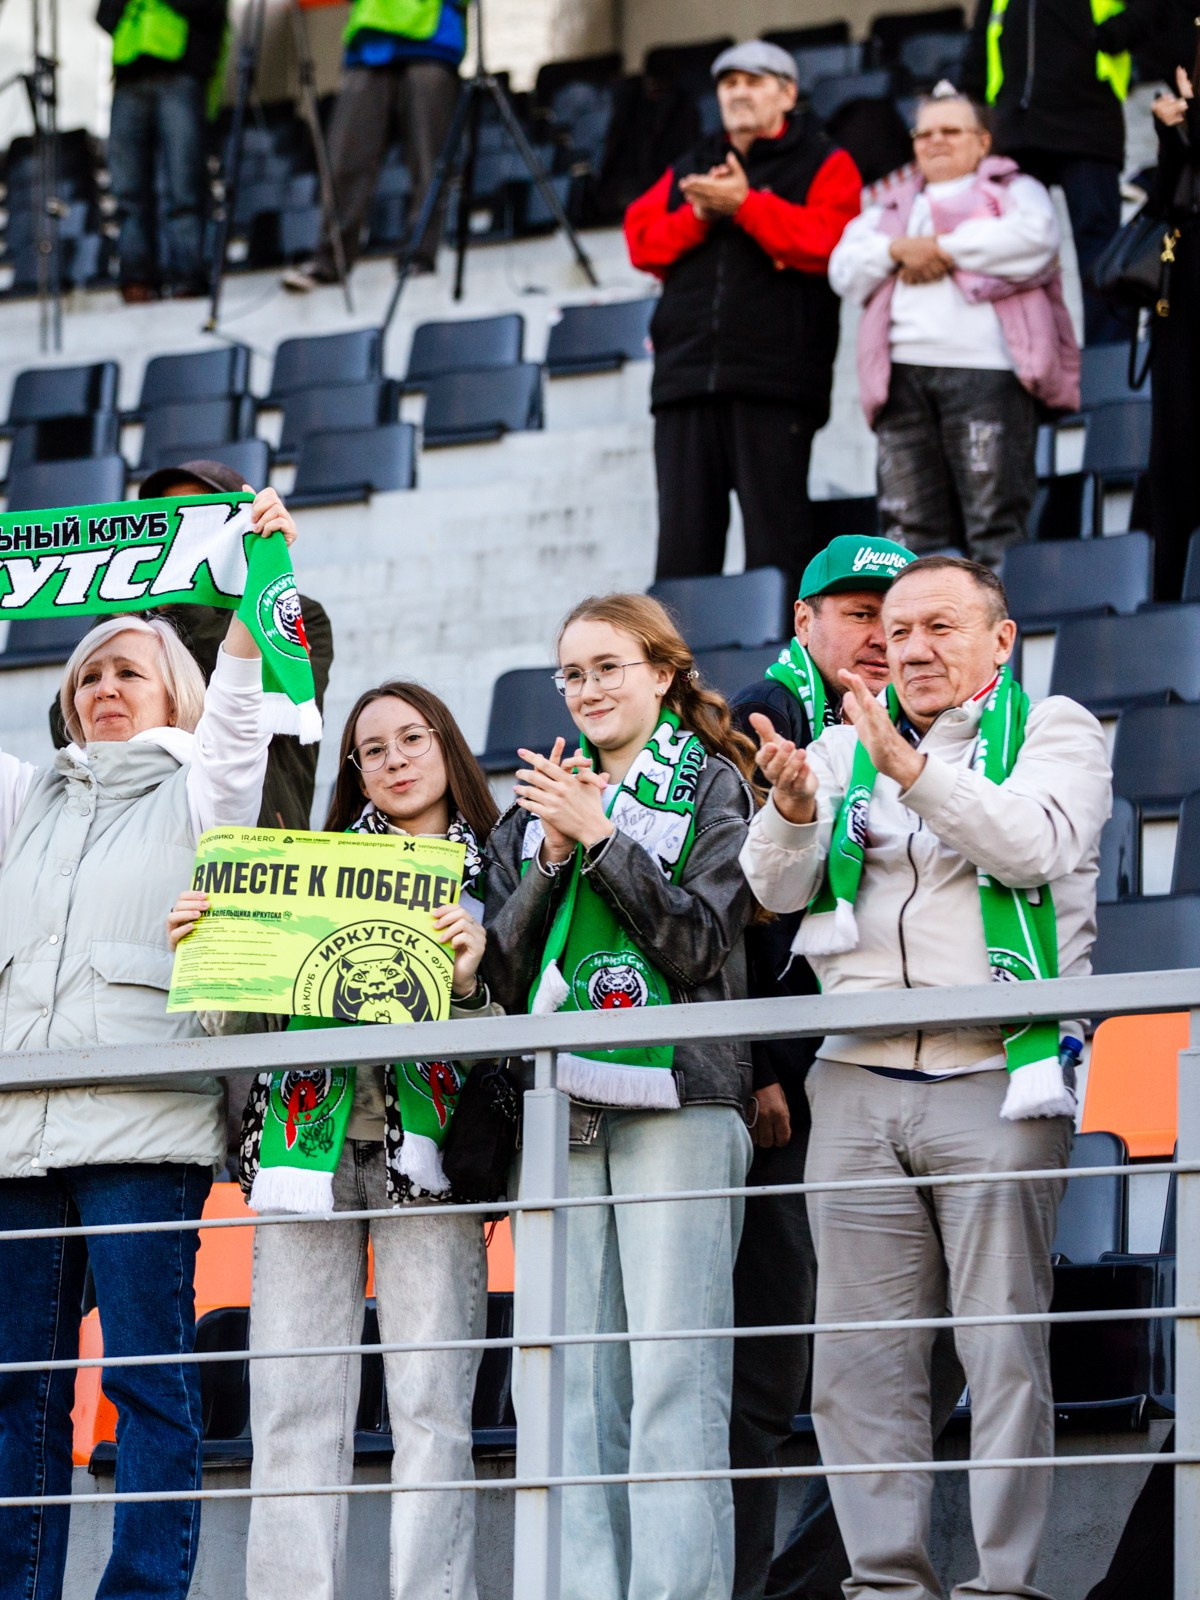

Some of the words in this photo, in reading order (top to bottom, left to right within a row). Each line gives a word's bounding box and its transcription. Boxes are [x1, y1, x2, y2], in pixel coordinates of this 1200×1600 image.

[88, 512, 169, 543] КЛУБ
[192, 861, 299, 896] ВМЕСТЕ
[308, 865, 328, 897] К
[336, 866, 459, 912] ПОБЕДЕ!
[212, 909, 251, 918] БОЛЕЛЬЩИКА
[252, 910, 282, 919] ИРКУТСКА
[319, 926, 422, 962] ИРКУТСК
[303, 973, 316, 1001] КЛУБ
[332, 1076, 344, 1087] 20
